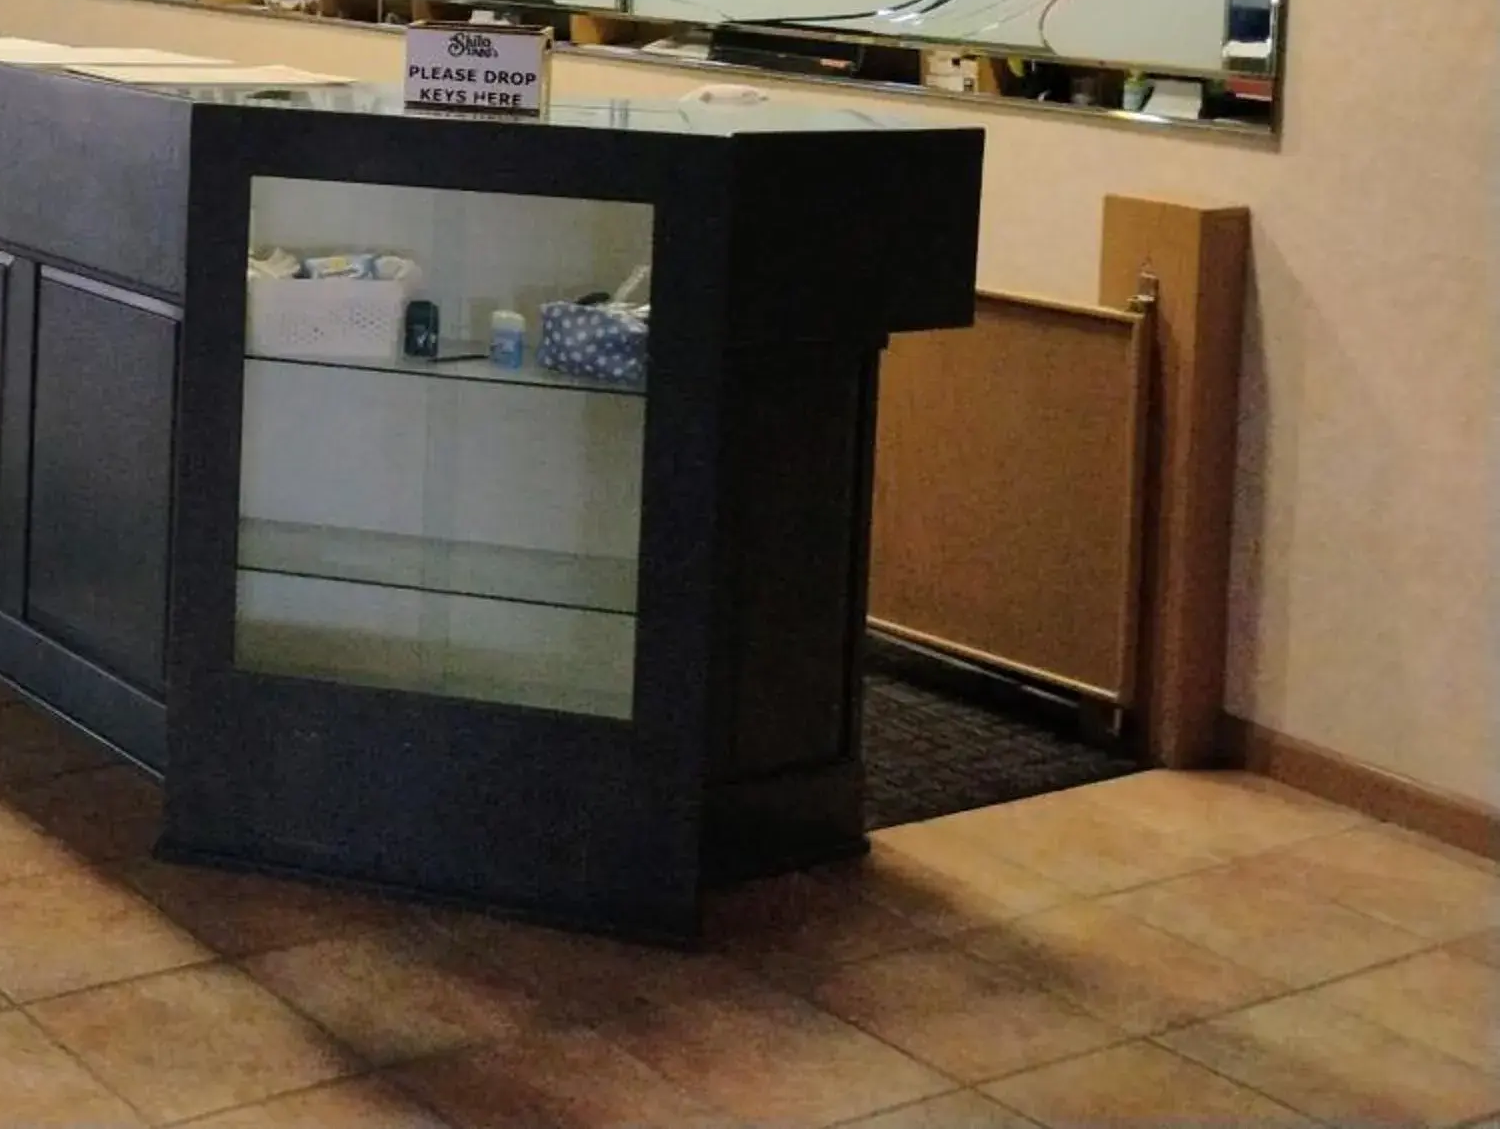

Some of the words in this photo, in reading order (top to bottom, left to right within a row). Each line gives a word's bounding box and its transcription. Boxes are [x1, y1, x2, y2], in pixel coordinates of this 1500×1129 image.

[409, 65, 477, 82] PLEASE
[484, 70, 537, 86] DROP
[420, 88, 467, 103] KEYS
[473, 91, 522, 106] HERE
